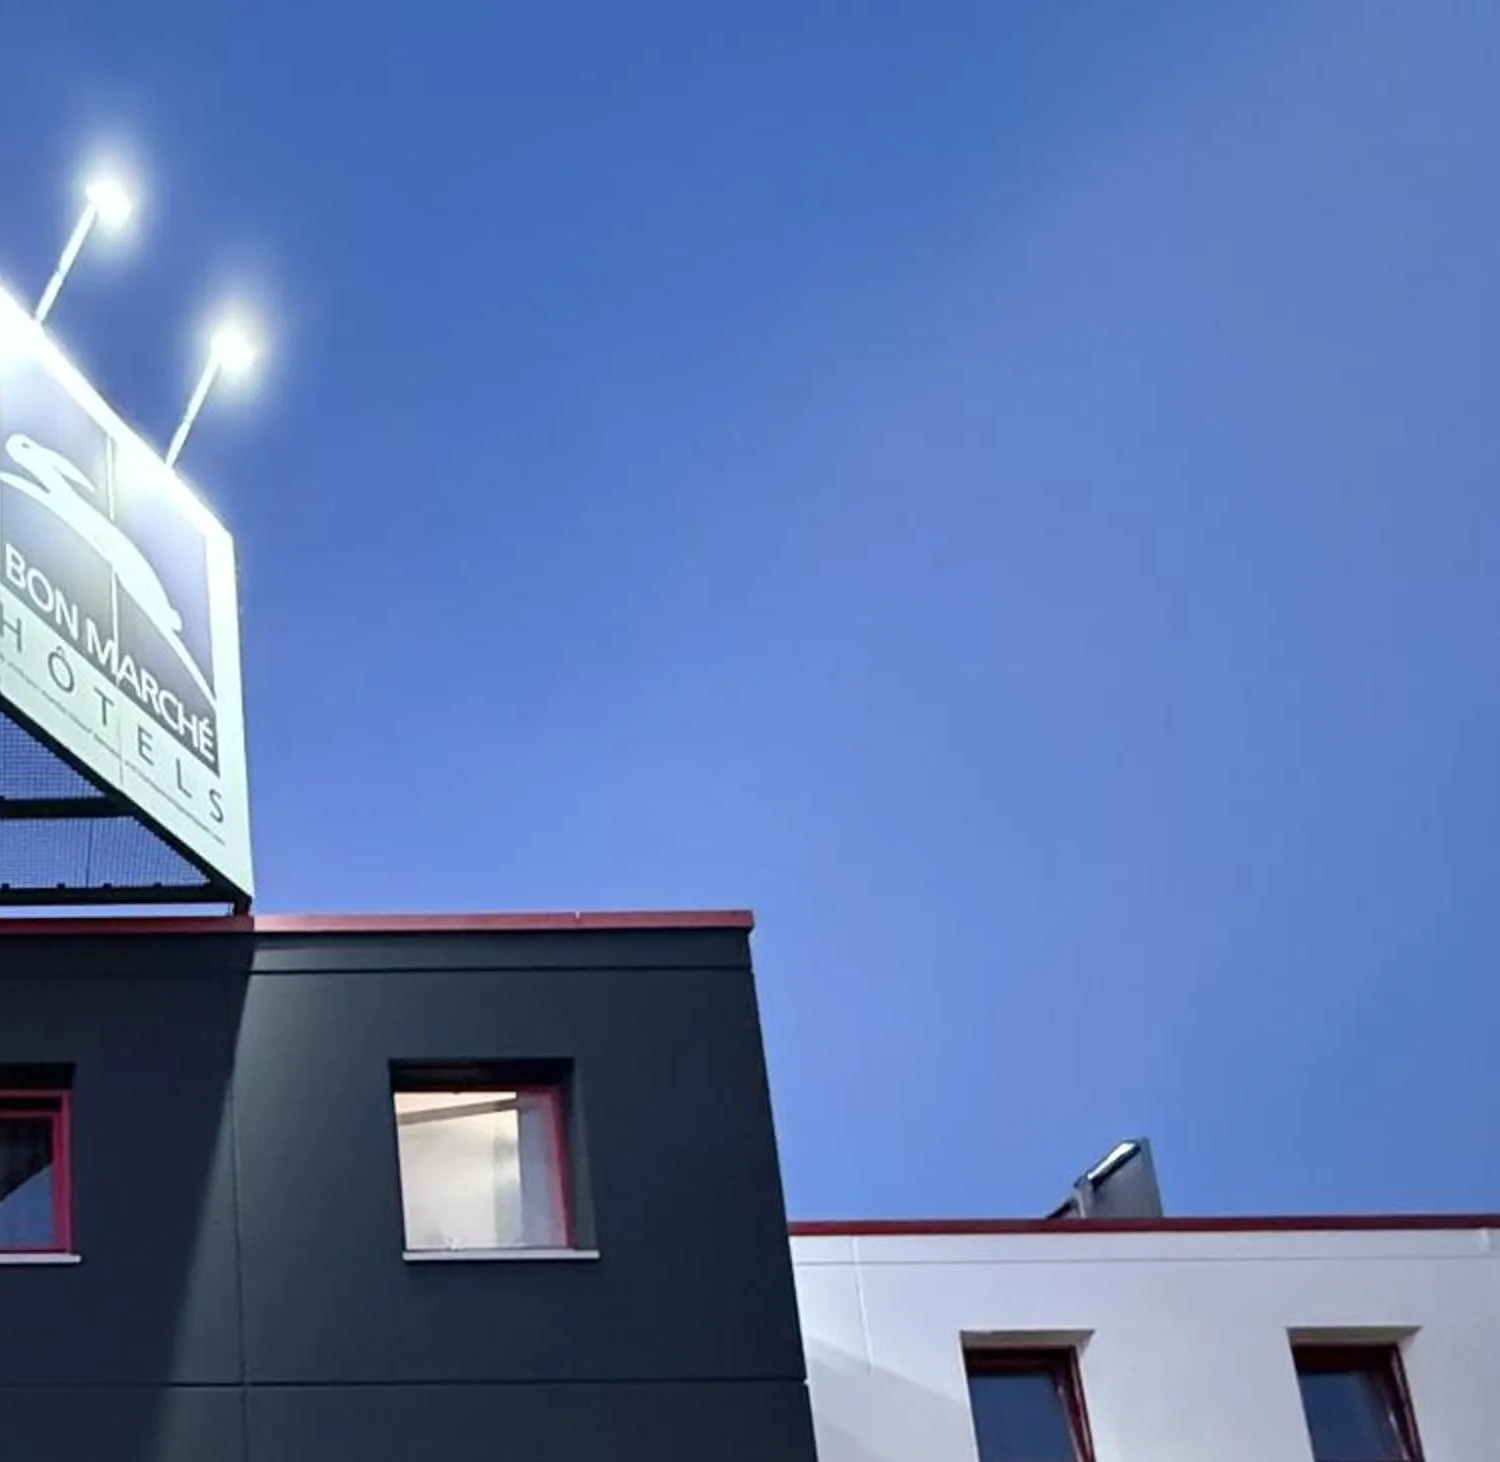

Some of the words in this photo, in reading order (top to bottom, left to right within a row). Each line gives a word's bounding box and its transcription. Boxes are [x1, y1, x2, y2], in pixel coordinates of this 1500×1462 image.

[0, 600, 225, 824] HÔTELS
[4, 544, 79, 641] BON
[86, 617, 216, 764] MARCHÉ
